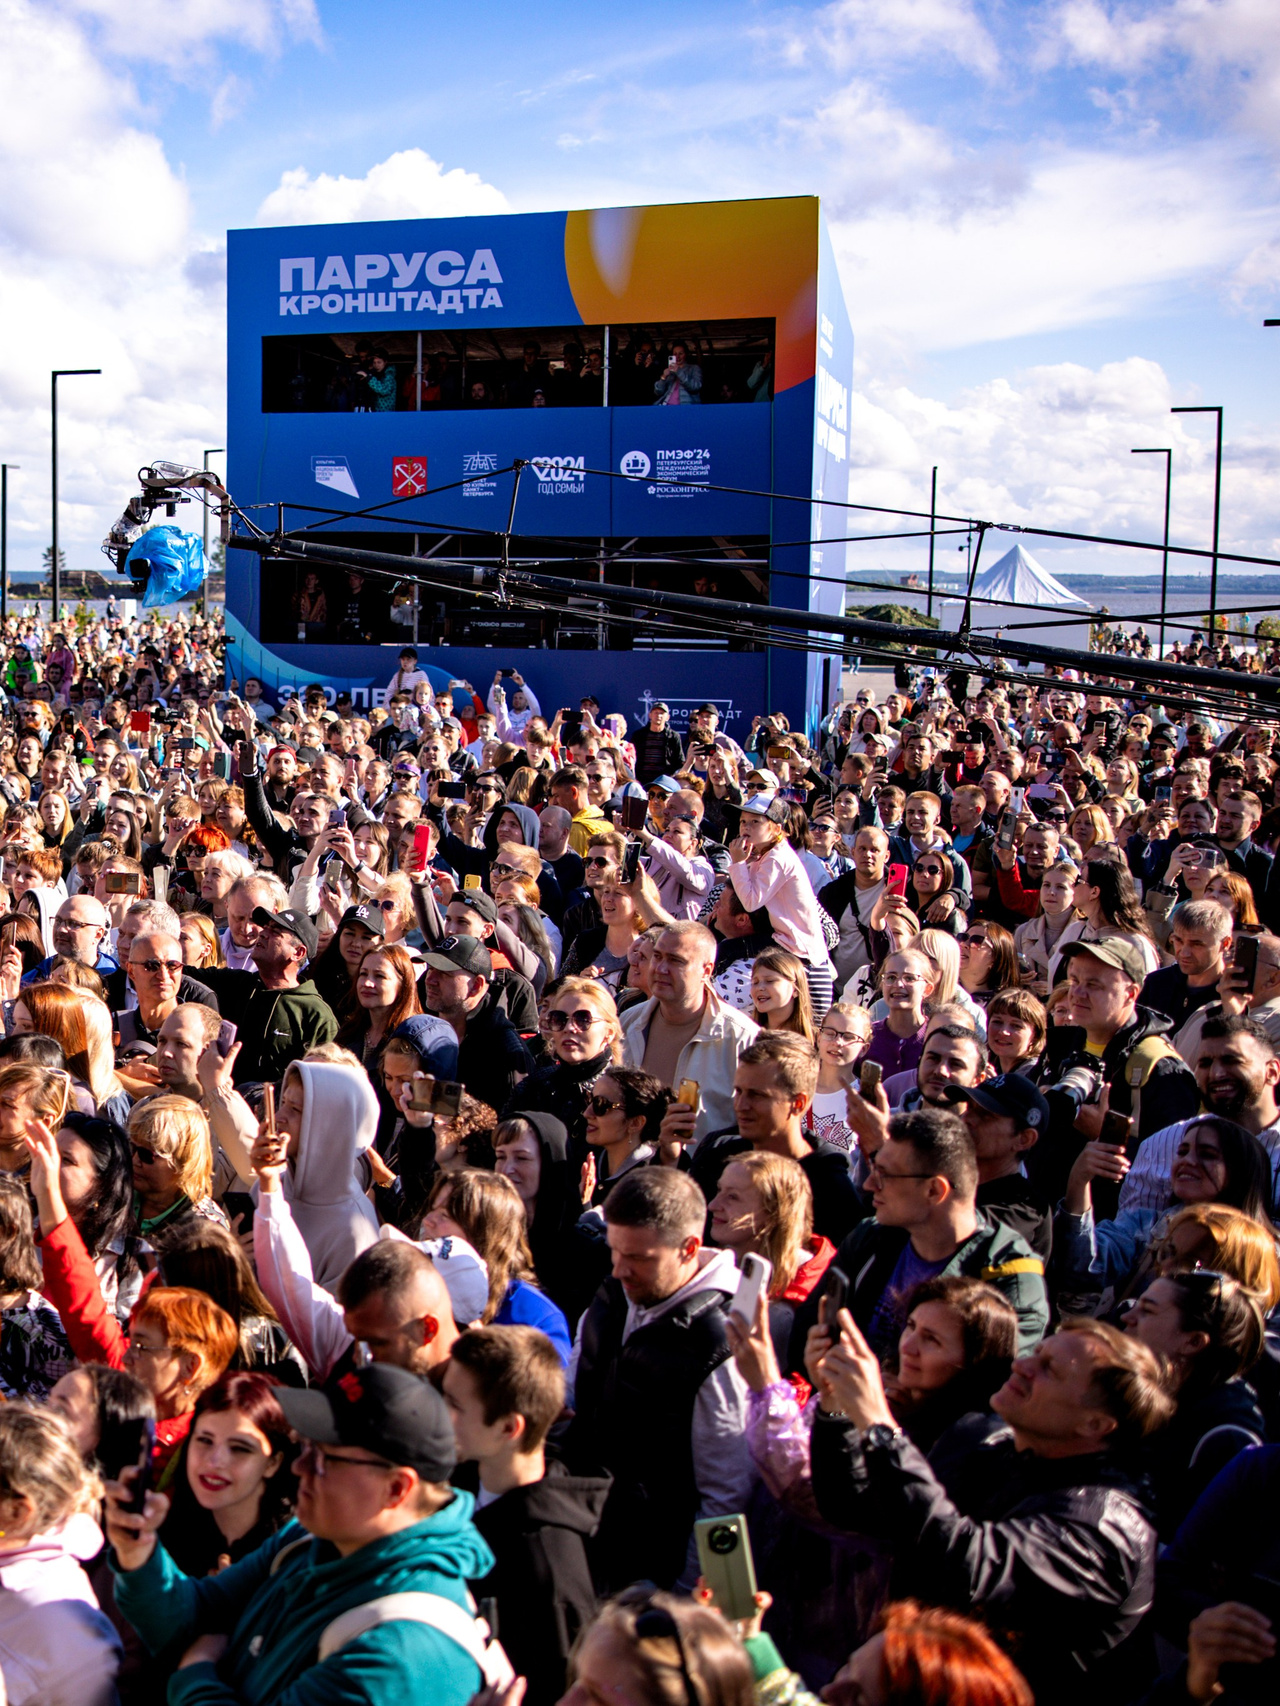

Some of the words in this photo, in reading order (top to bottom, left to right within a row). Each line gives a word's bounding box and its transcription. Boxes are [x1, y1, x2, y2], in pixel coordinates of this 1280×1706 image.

[279, 249, 504, 292] ПАРУСА
[279, 287, 504, 316] КРОНШТАДТА
[532, 456, 586, 481] 2024
[355, 905, 370, 919] LA
